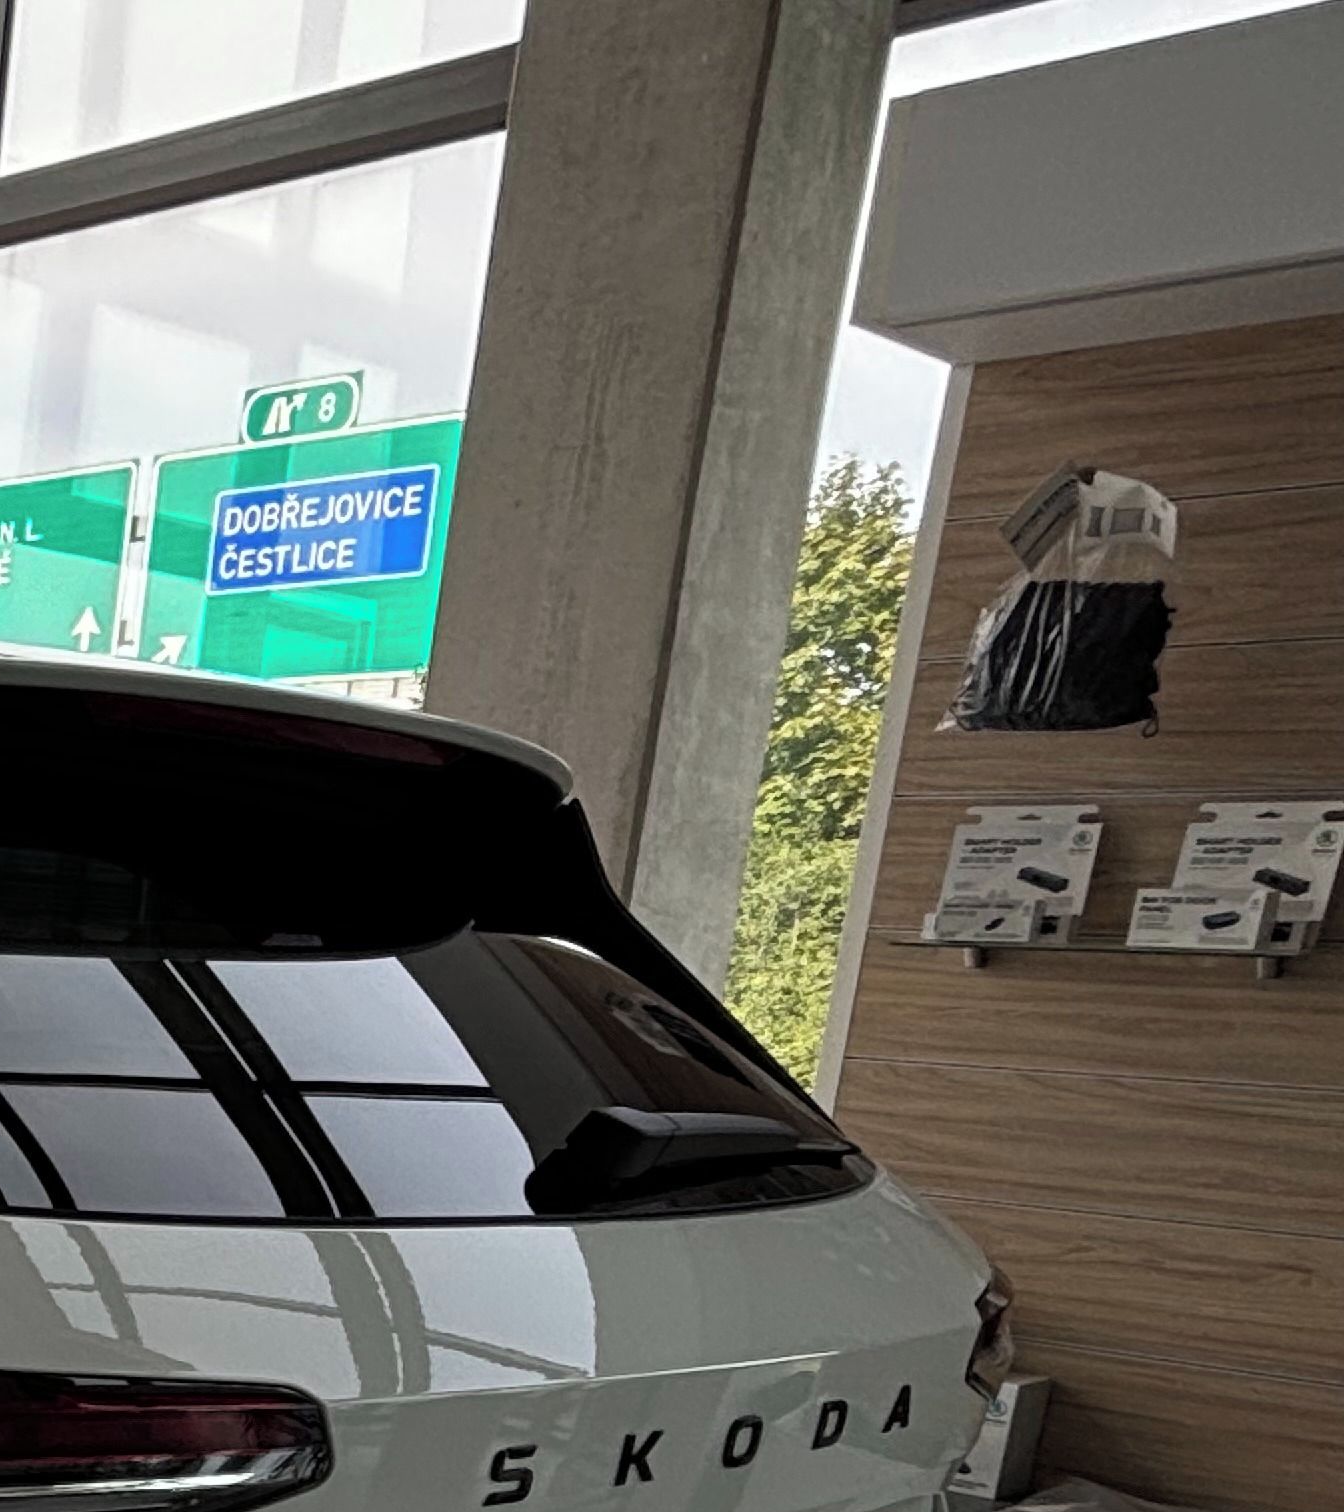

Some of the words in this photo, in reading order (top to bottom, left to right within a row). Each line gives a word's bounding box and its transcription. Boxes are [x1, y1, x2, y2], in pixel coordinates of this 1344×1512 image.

[318, 391, 337, 423] 8
[222, 483, 426, 537] DOBŘEJOVICE
[218, 537, 358, 581] ČESTLICE
